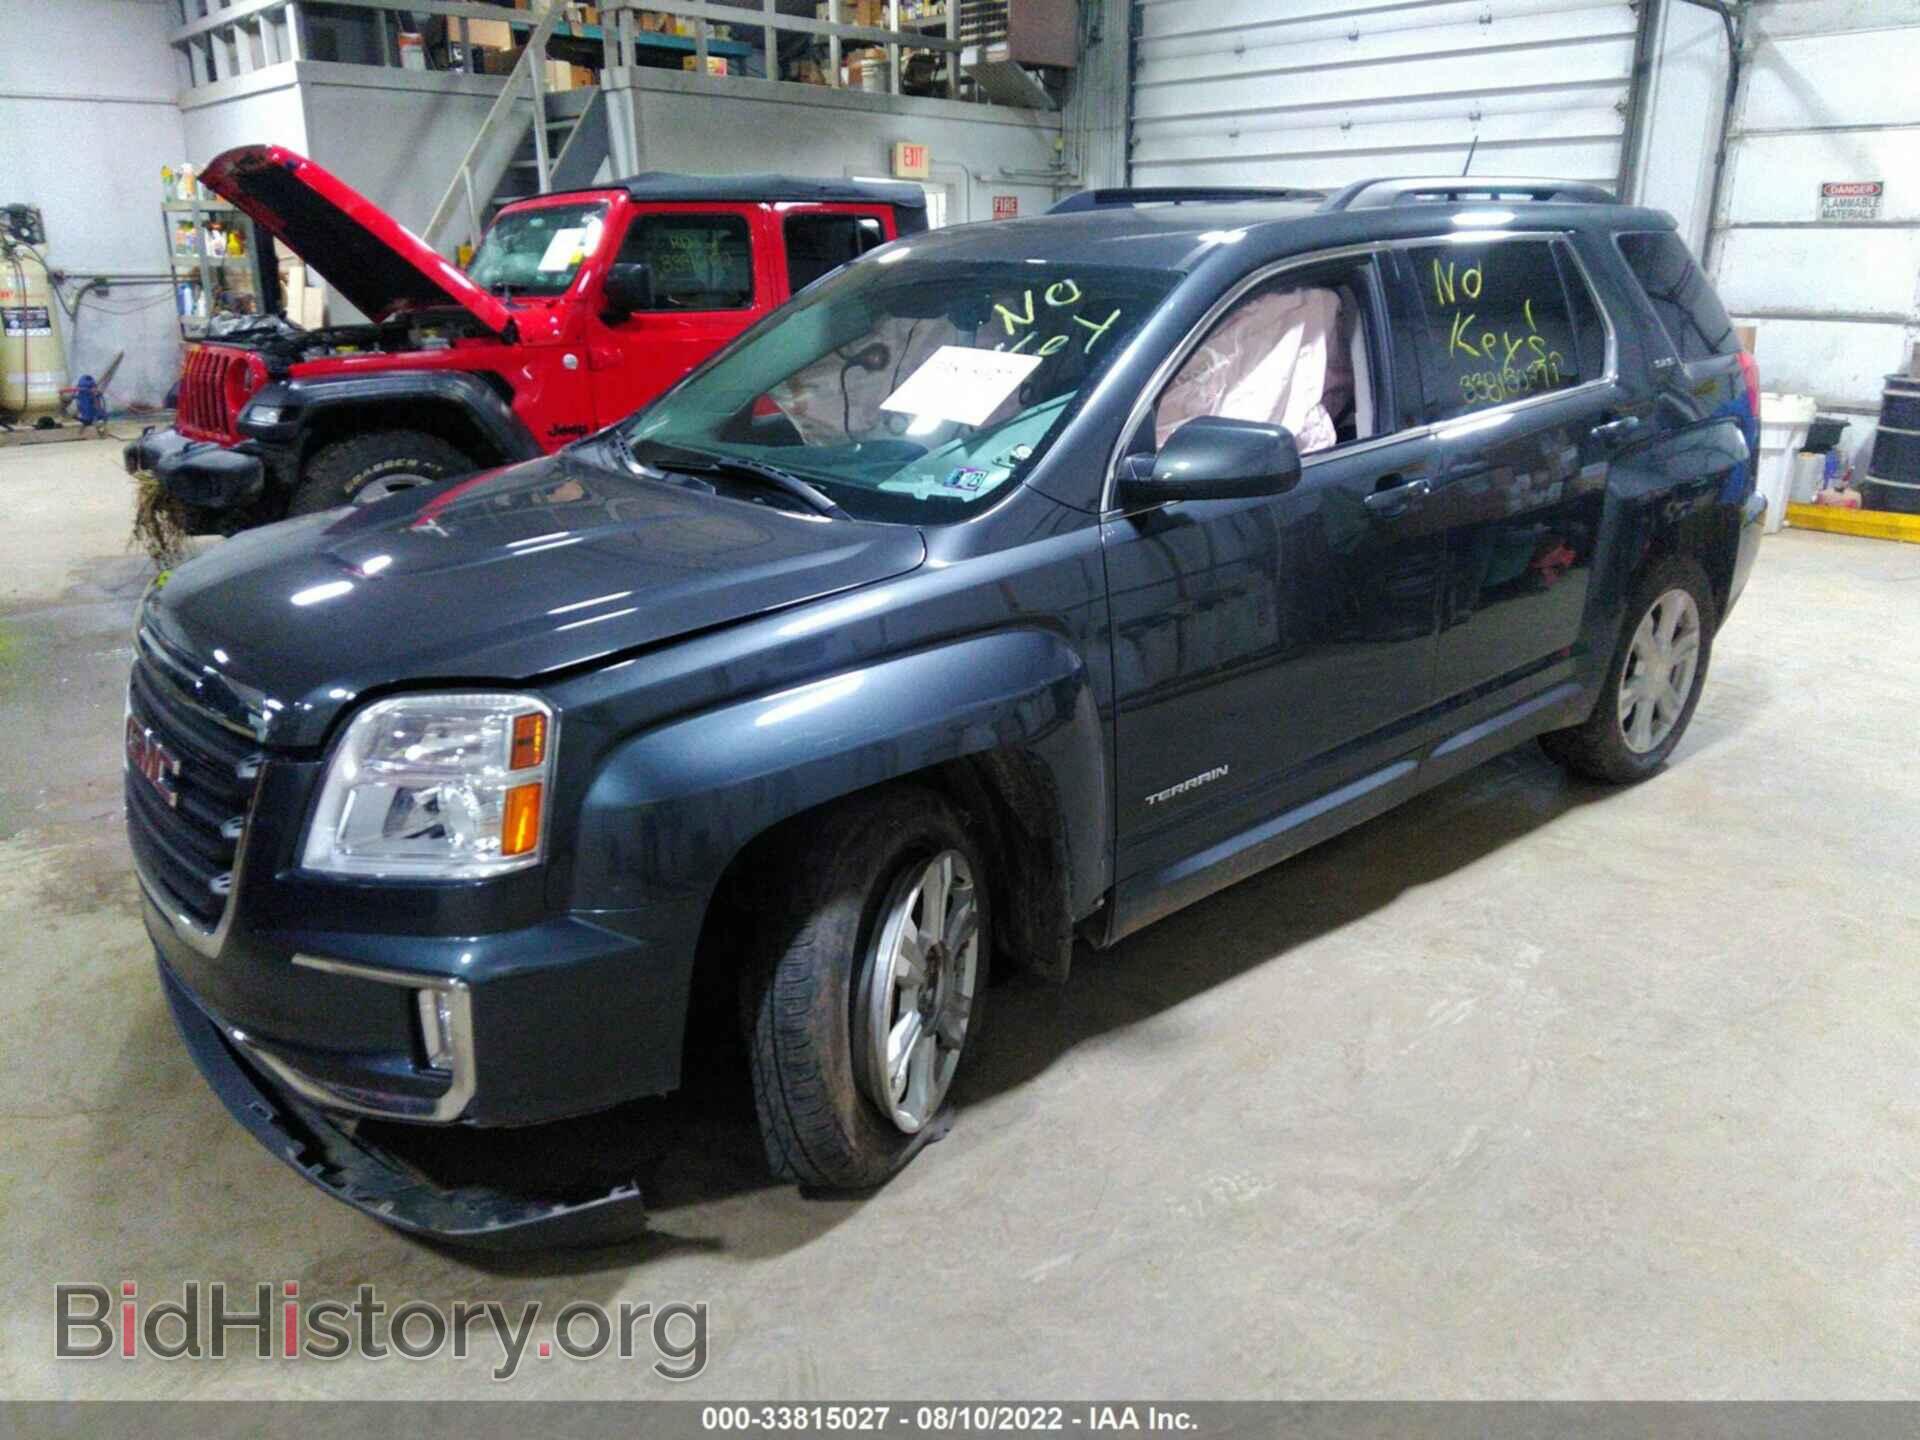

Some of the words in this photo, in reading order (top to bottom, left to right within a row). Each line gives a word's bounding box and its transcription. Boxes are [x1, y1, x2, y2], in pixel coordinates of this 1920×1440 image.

[904, 146, 922, 167] EXIT
[1830, 184, 1872, 195] DANGER
[994, 198, 1016, 212] FIRE
[1821, 197, 1880, 208] FLAMMABLE
[1144, 764, 1229, 805] TERRAIN
